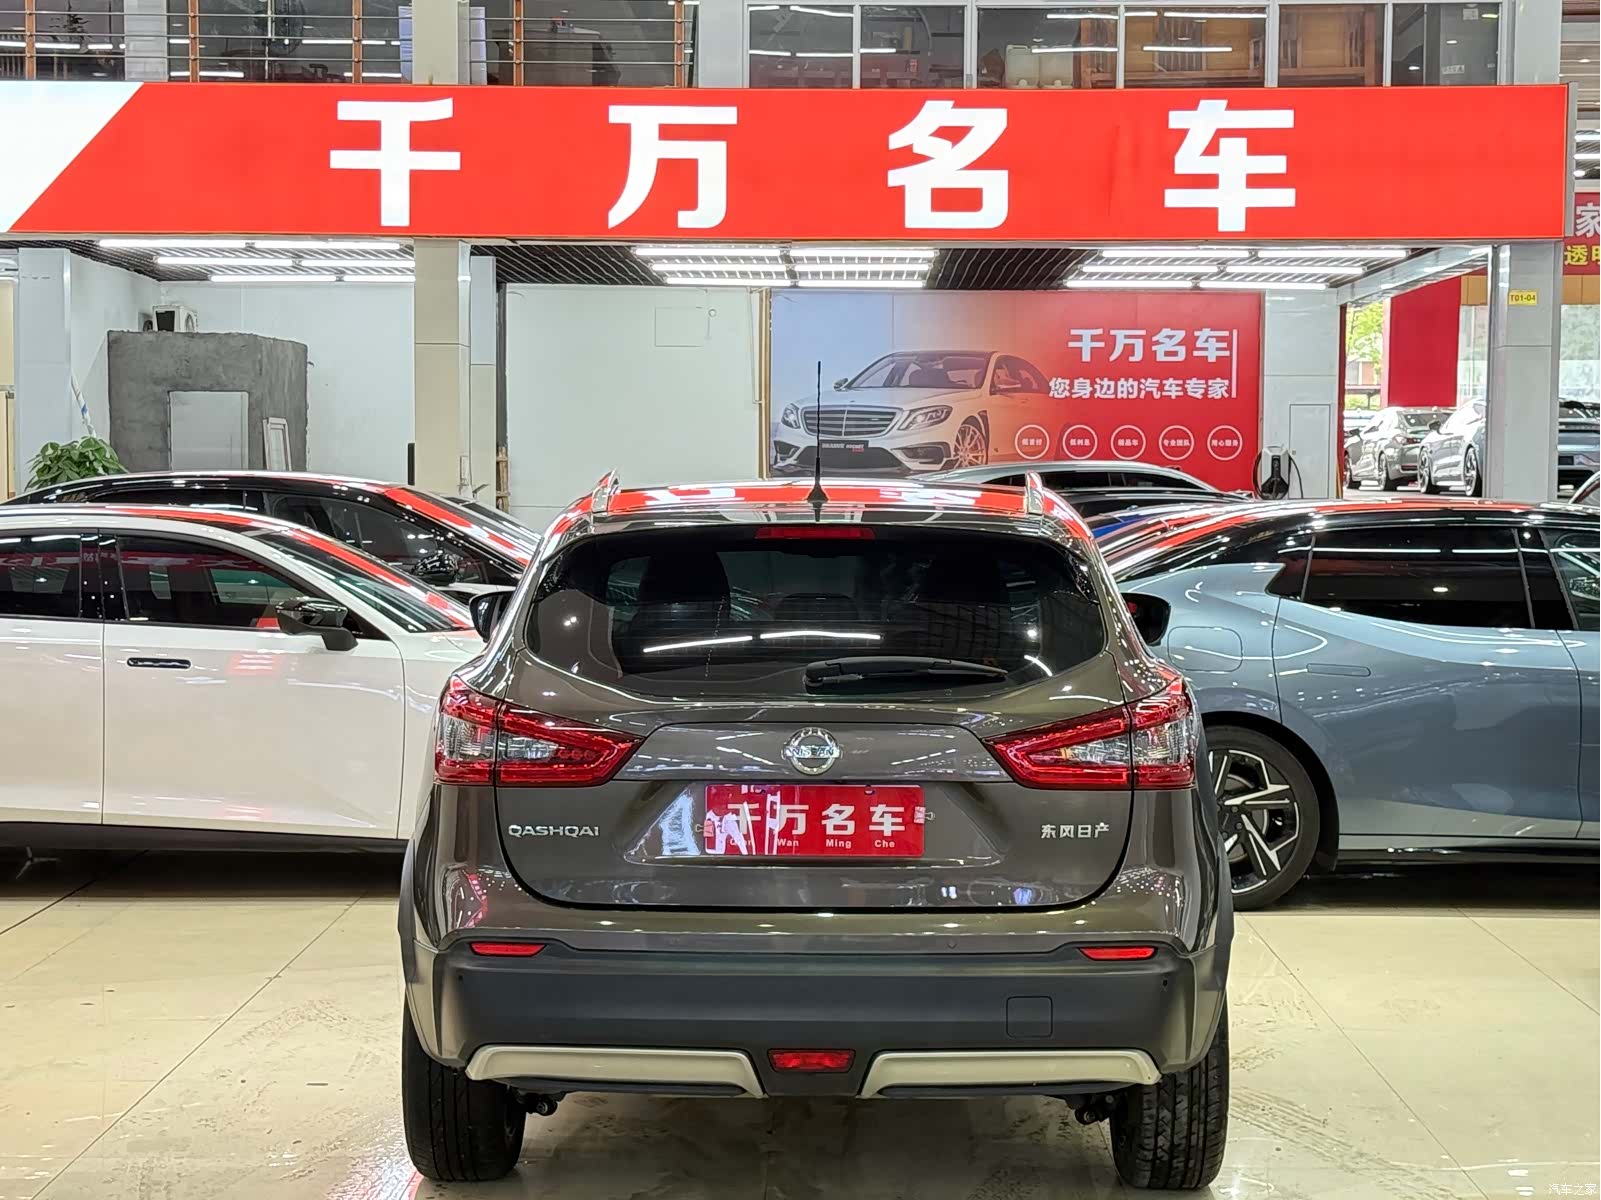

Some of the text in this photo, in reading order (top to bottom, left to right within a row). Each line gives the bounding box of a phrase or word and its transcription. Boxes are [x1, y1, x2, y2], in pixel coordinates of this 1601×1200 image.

[330, 97, 1296, 232] 千万名车
[1575, 202, 1600, 238] 家
[1510, 294, 1536, 302] T01-04
[1068, 328, 1231, 363] 千万名车
[1049, 377, 1230, 400] 您身边的汽车专家
[508, 824, 600, 838] QASHQAI
[727, 802, 906, 837] 千万名车
[1040, 822, 1110, 839] 东风日产
[778, 838, 799, 847] Wan
[825, 838, 852, 849] Ming
[874, 839, 896, 848] Che
